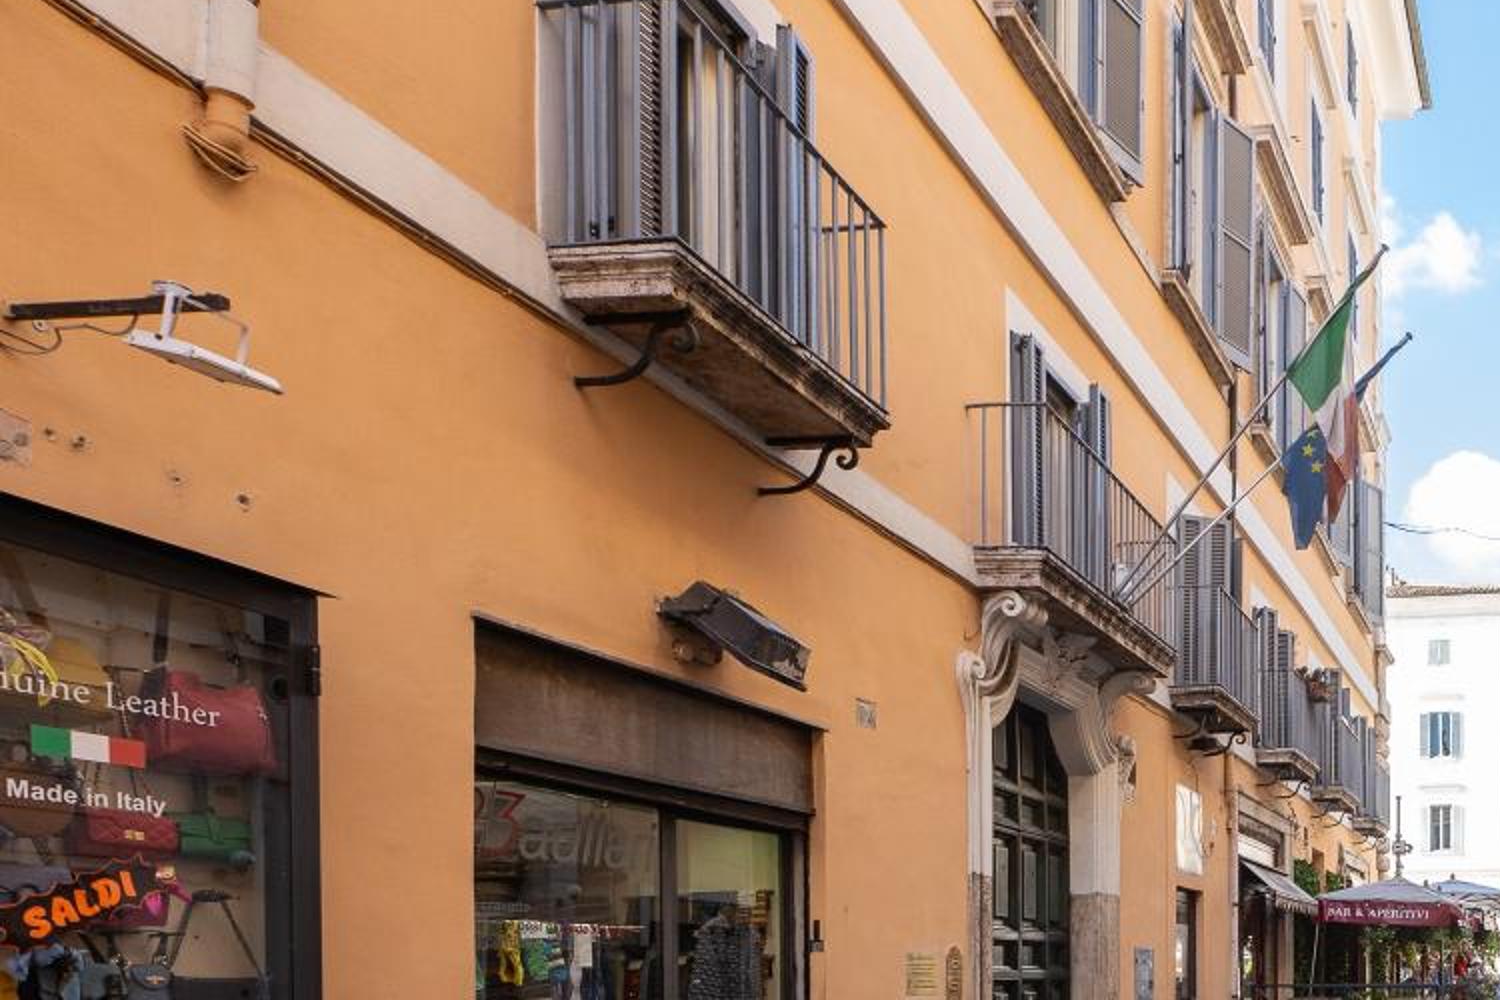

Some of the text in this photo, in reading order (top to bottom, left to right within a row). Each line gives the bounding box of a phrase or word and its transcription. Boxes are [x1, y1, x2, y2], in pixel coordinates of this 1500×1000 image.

[106, 681, 221, 727] Leather
[6, 778, 167, 818] Made in Italy
[23, 870, 136, 939] SALDI
[1327, 907, 1350, 917] BAR
[1367, 909, 1429, 920] APERITIVI
